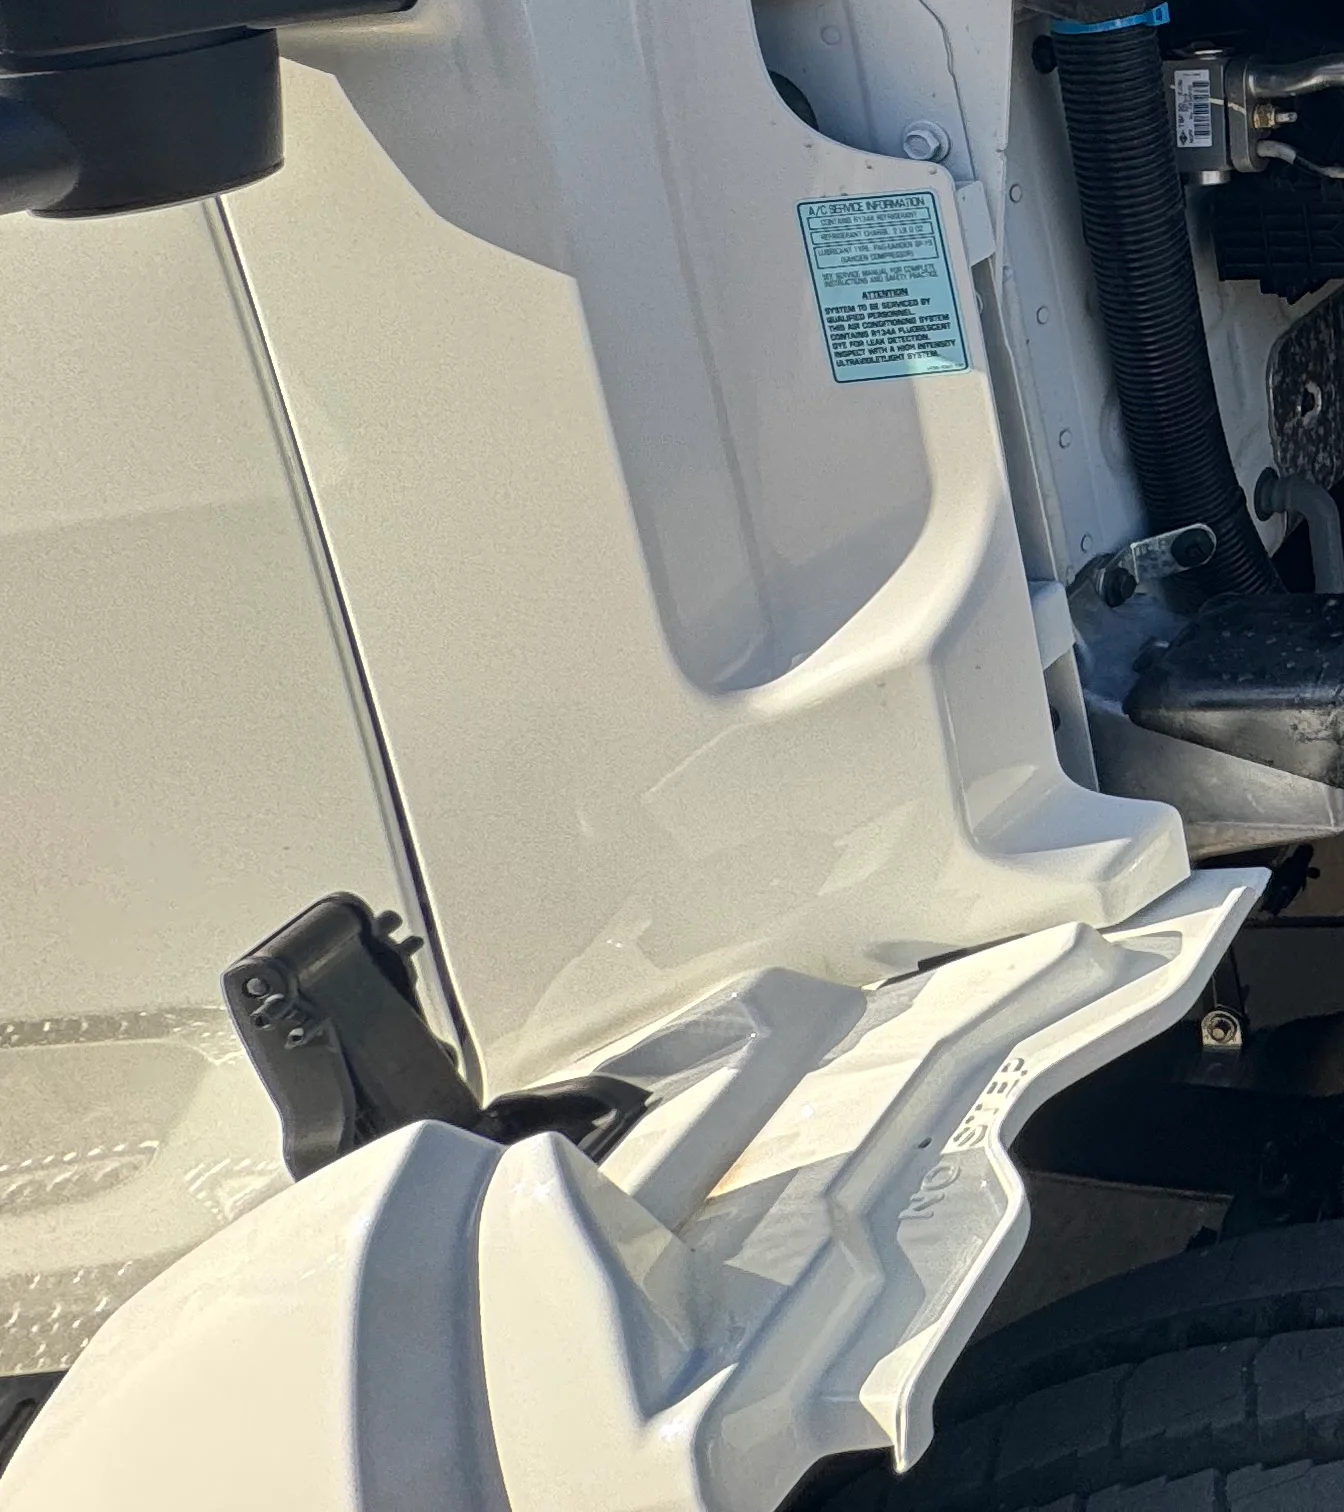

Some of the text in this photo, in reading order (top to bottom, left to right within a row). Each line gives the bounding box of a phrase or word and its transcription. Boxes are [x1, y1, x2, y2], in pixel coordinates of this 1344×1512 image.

[808, 197, 925, 217] A/C SERVICE INFORMATION
[862, 288, 909, 300] ATTENTION
[824, 306, 856, 315] SYSTEM
[881, 299, 919, 309] SERVICED
[953, 1058, 1028, 1148] STEP
